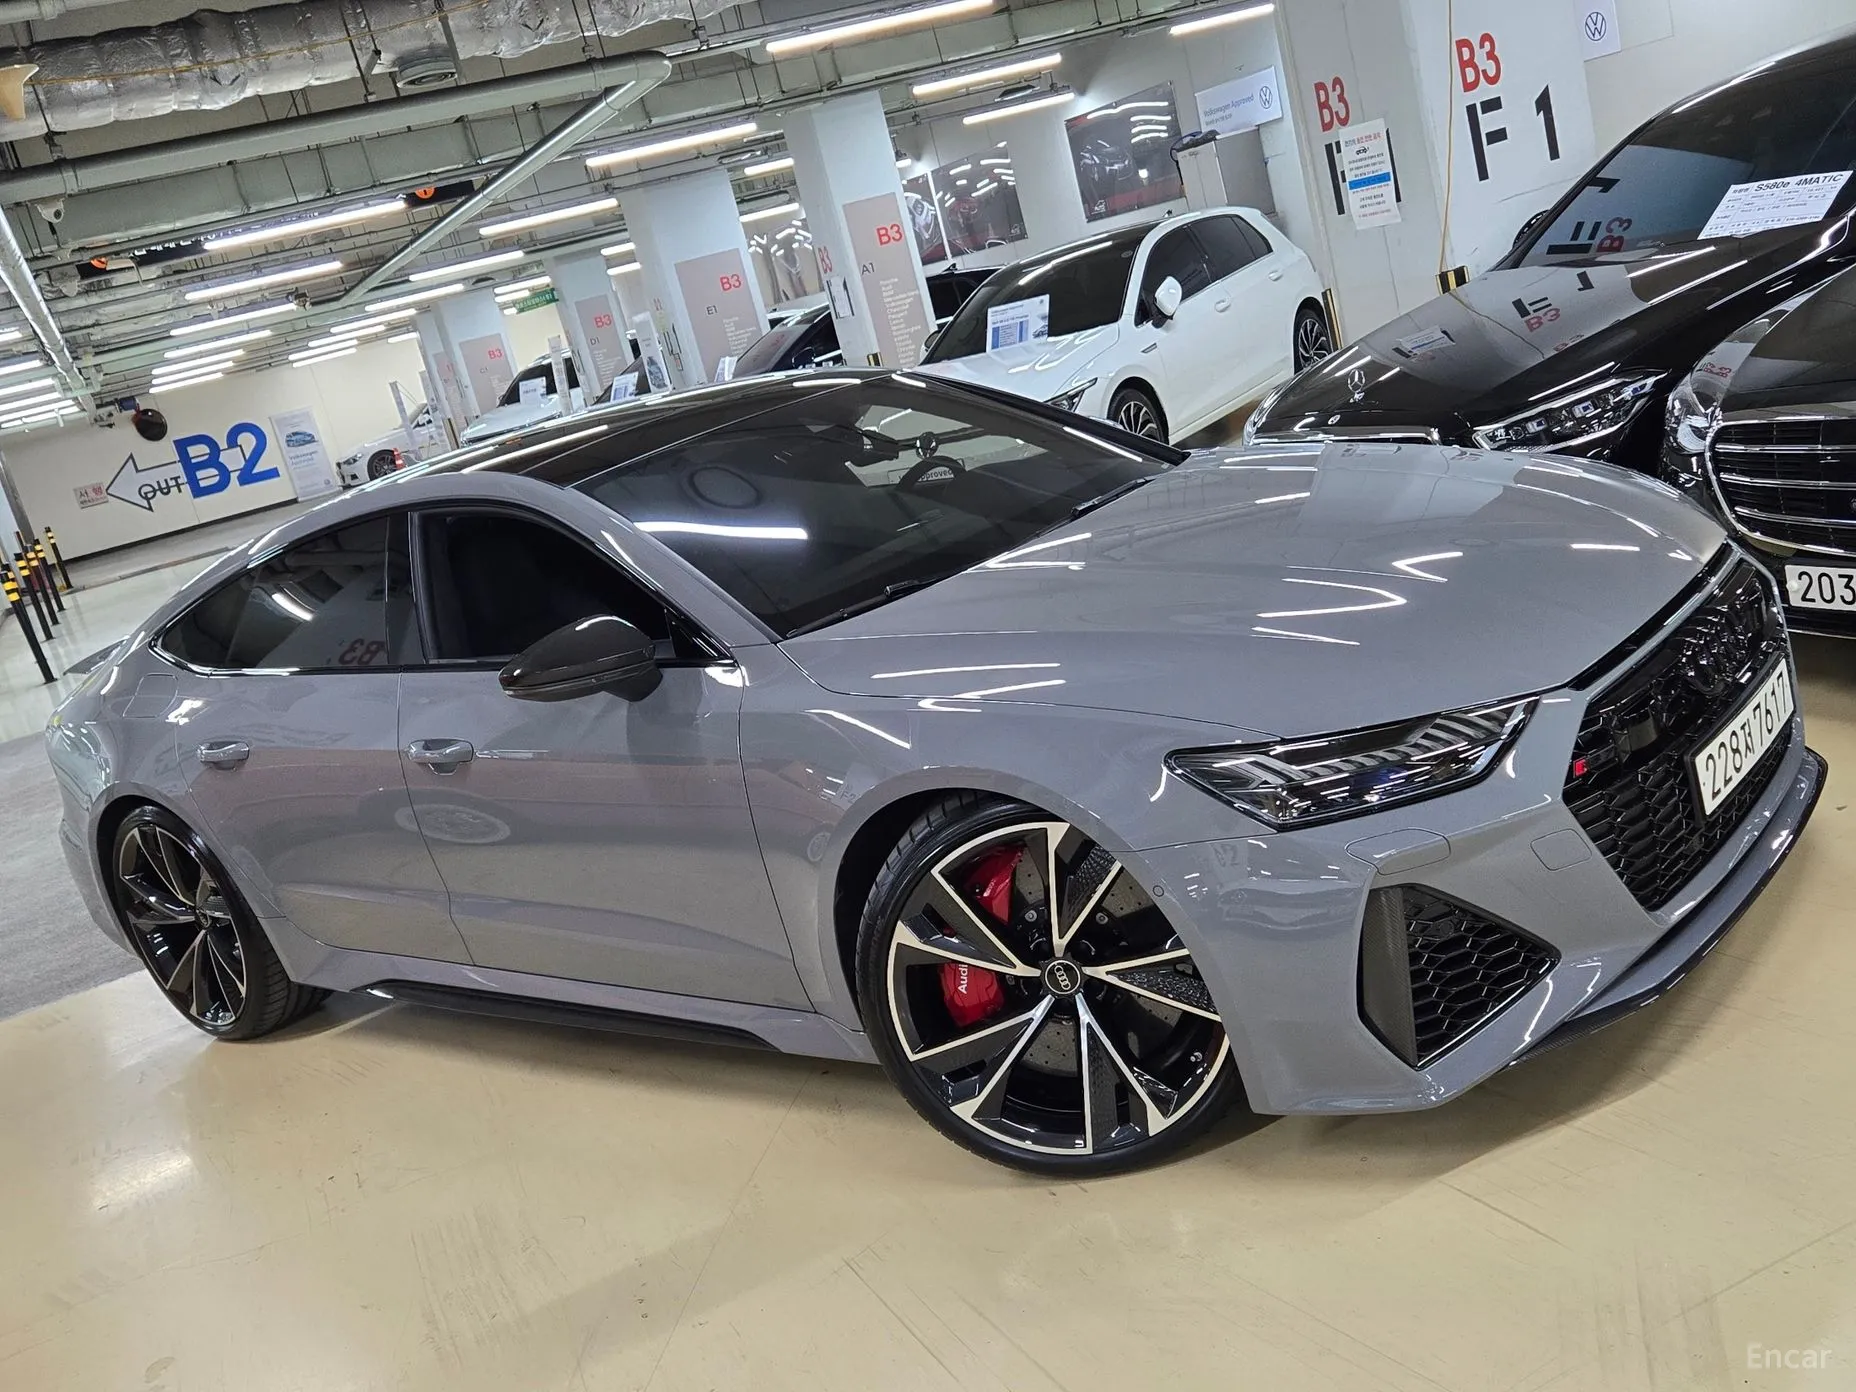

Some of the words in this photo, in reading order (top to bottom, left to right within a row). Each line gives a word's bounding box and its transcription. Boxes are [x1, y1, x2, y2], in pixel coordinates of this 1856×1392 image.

[1455, 33, 1501, 92] B3
[1314, 76, 1350, 132] B3
[1466, 96, 1508, 182] F
[1535, 84, 1560, 161] 1
[1754, 180, 1790, 192] S580e
[1795, 173, 1844, 187] 4MATIC
[877, 223, 903, 246] B3
[861, 262, 875, 275] A1
[720, 274, 741, 291] B3
[594, 314, 612, 328] B3
[706, 305, 718, 315] E1
[488, 348, 503, 359] B3
[173, 422, 280, 499] B2
[138, 476, 182, 500] OUT
[1798, 571, 1856, 605] 203
[958, 964, 969, 994] Audi
